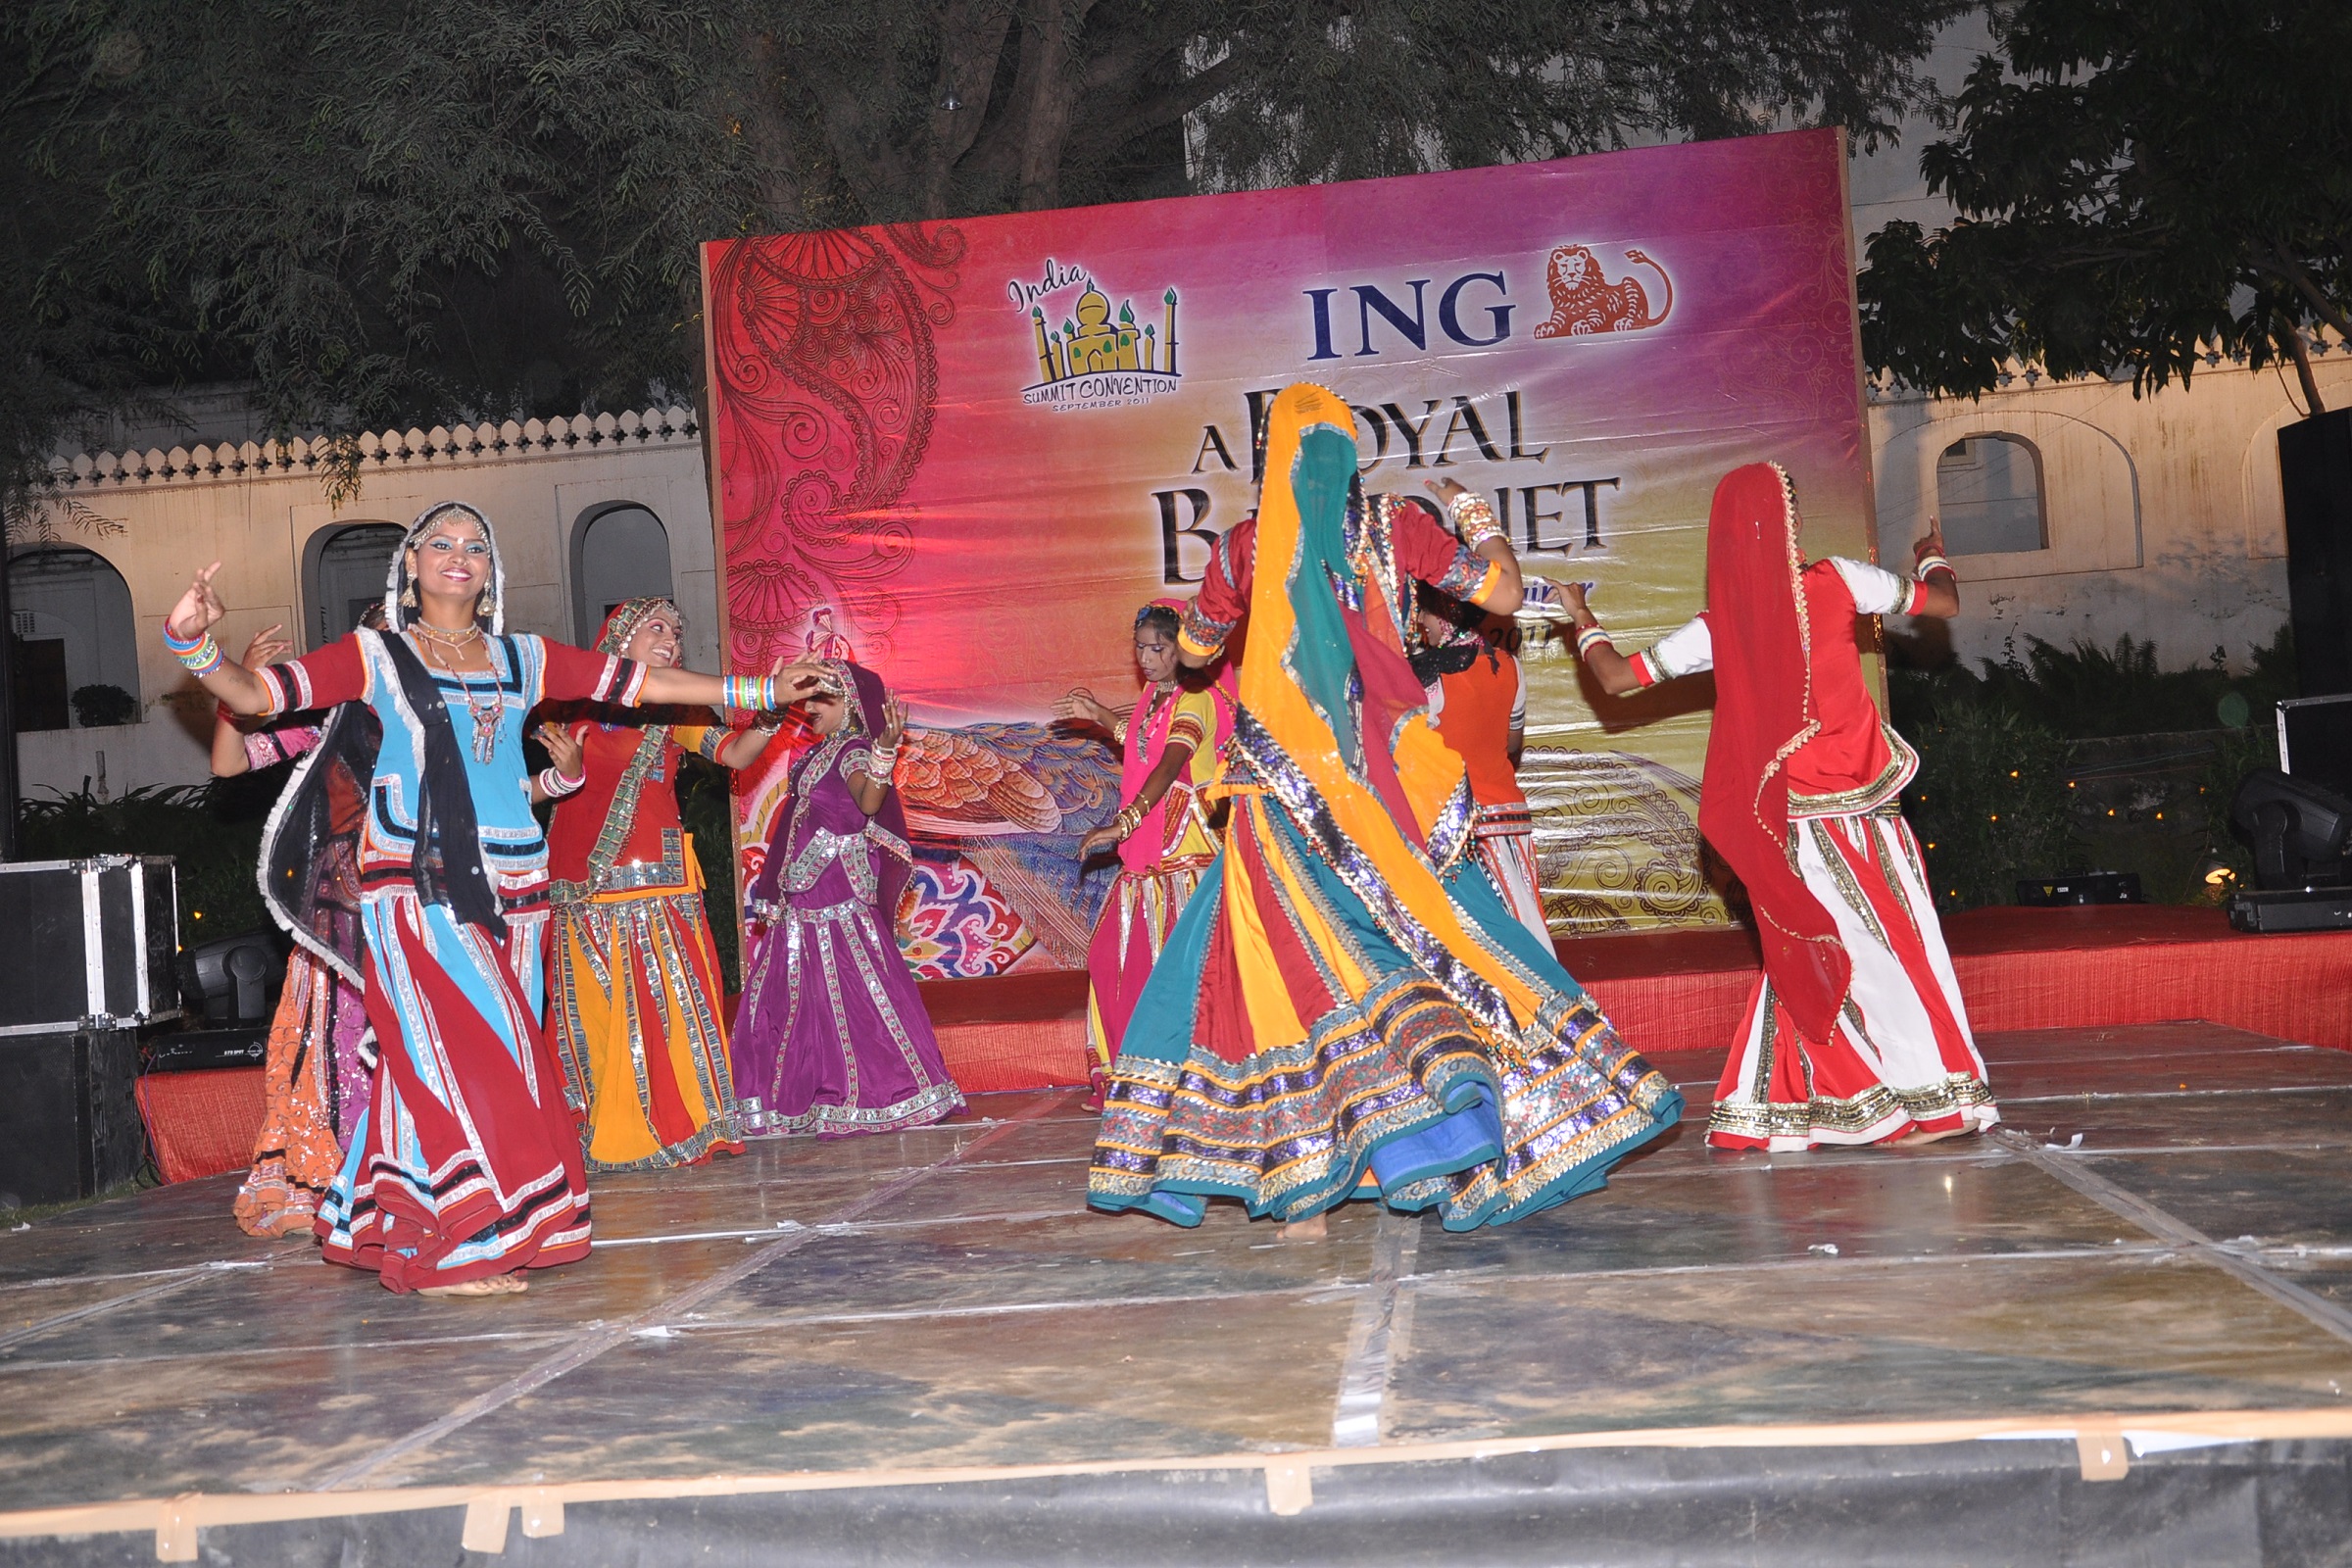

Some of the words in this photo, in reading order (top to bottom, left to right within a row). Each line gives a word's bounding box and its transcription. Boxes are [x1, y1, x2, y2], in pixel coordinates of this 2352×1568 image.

[1007, 259, 1087, 313] India
[1303, 270, 1517, 361] ING
[1022, 381, 1076, 405] SUMMIT
[1079, 375, 1177, 399] CONVENTION
[1052, 399, 1122, 412] SEPTEMBER
[1127, 397, 1150, 406] 2011
[1192, 424, 1240, 474] A
